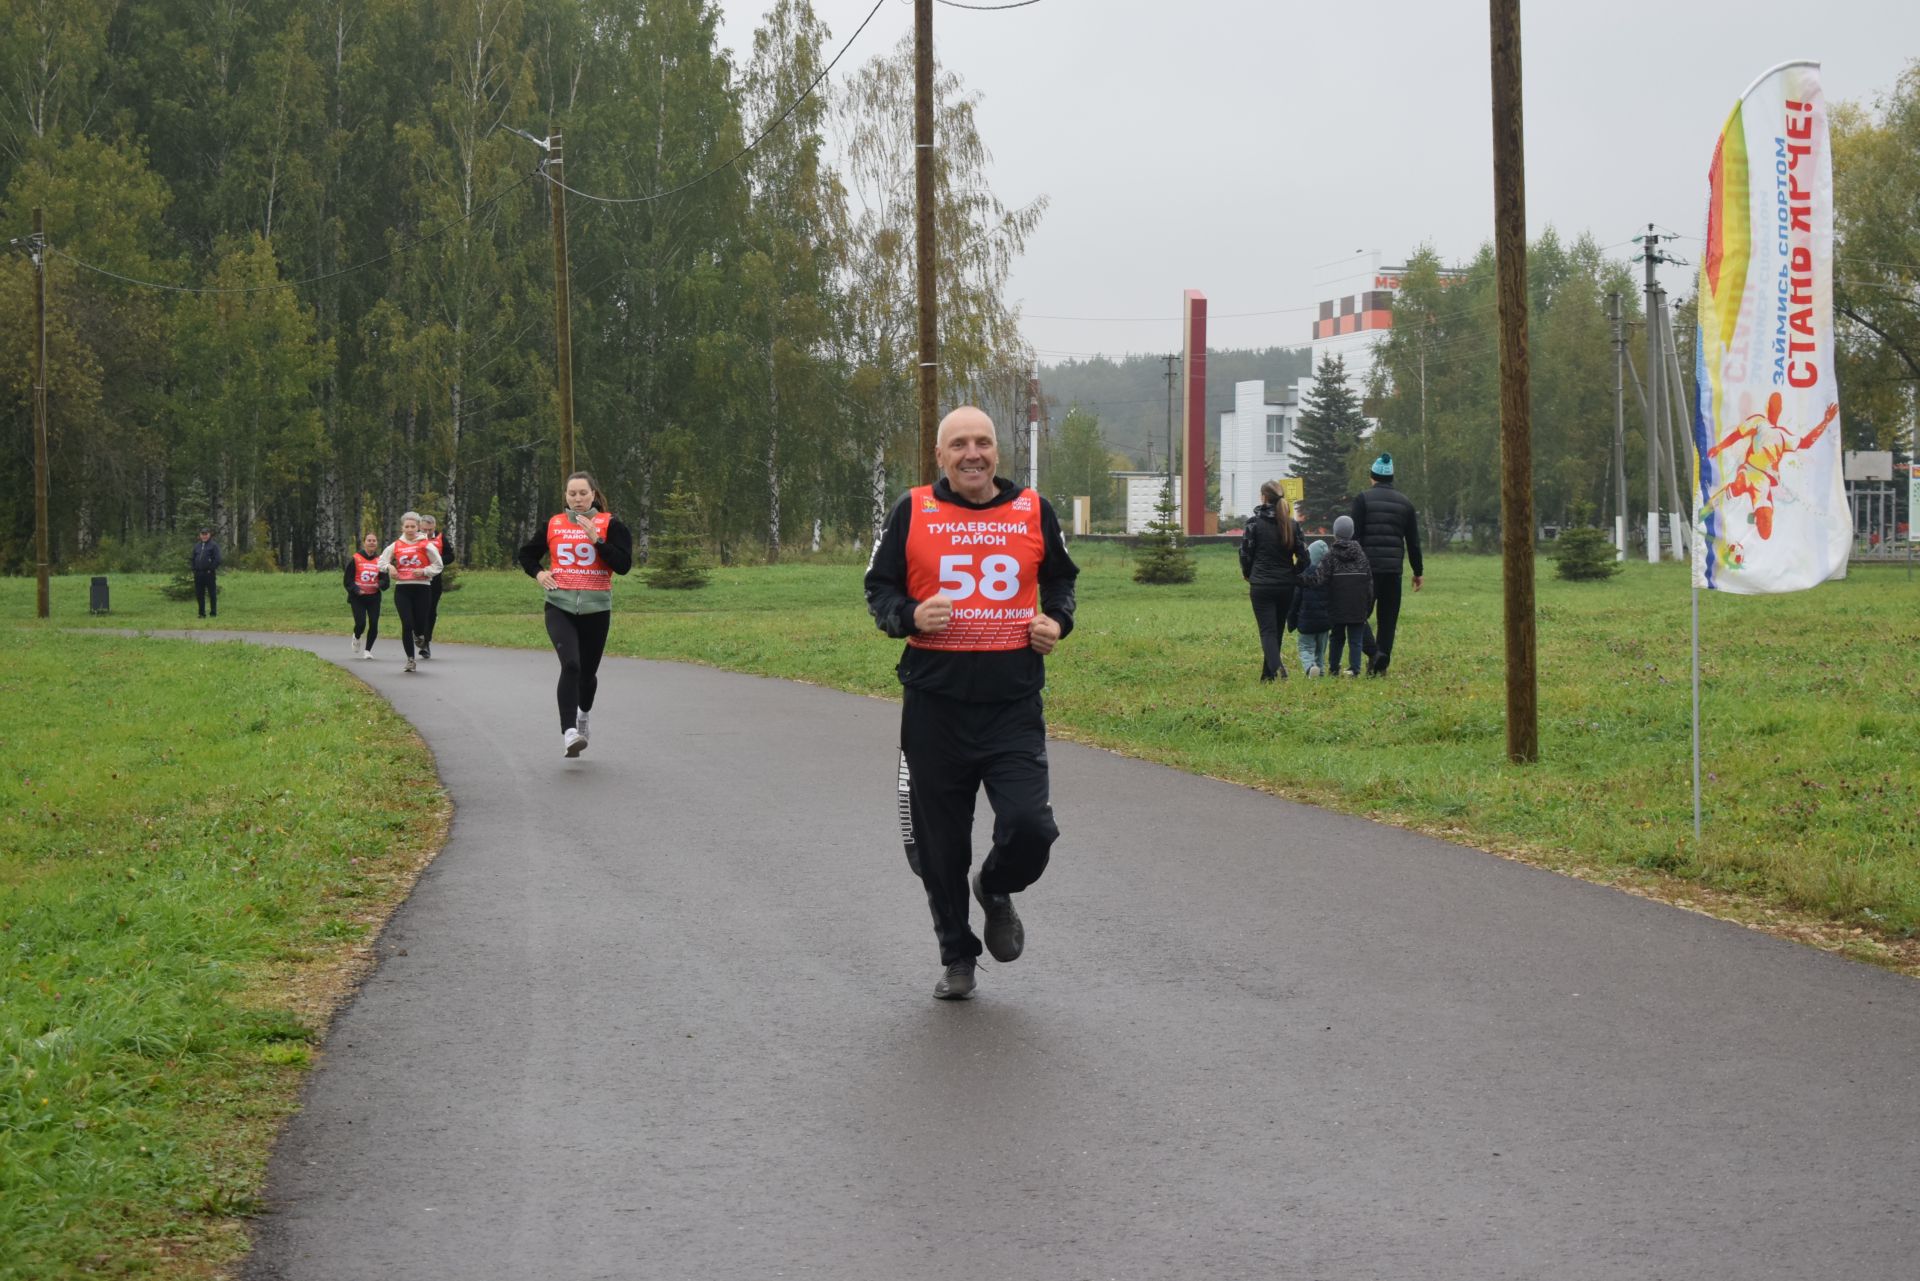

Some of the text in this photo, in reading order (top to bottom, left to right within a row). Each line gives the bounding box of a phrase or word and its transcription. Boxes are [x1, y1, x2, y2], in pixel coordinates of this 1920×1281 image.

[1785, 99, 1818, 388] СТАНЬ ЯРЧЕ!
[1772, 137, 1789, 385] ЗАЙМИСЬ СПОРТОМ
[927, 521, 1027, 535] ТУКАЕВСКИЙ
[951, 532, 1006, 546] РАЙОН
[399, 554, 421, 566] 64
[556, 543, 596, 567] 59
[361, 570, 378, 582] 67
[938, 554, 1020, 601] 58
[955, 607, 1034, 619] НОРМА ЖИЗНИ
